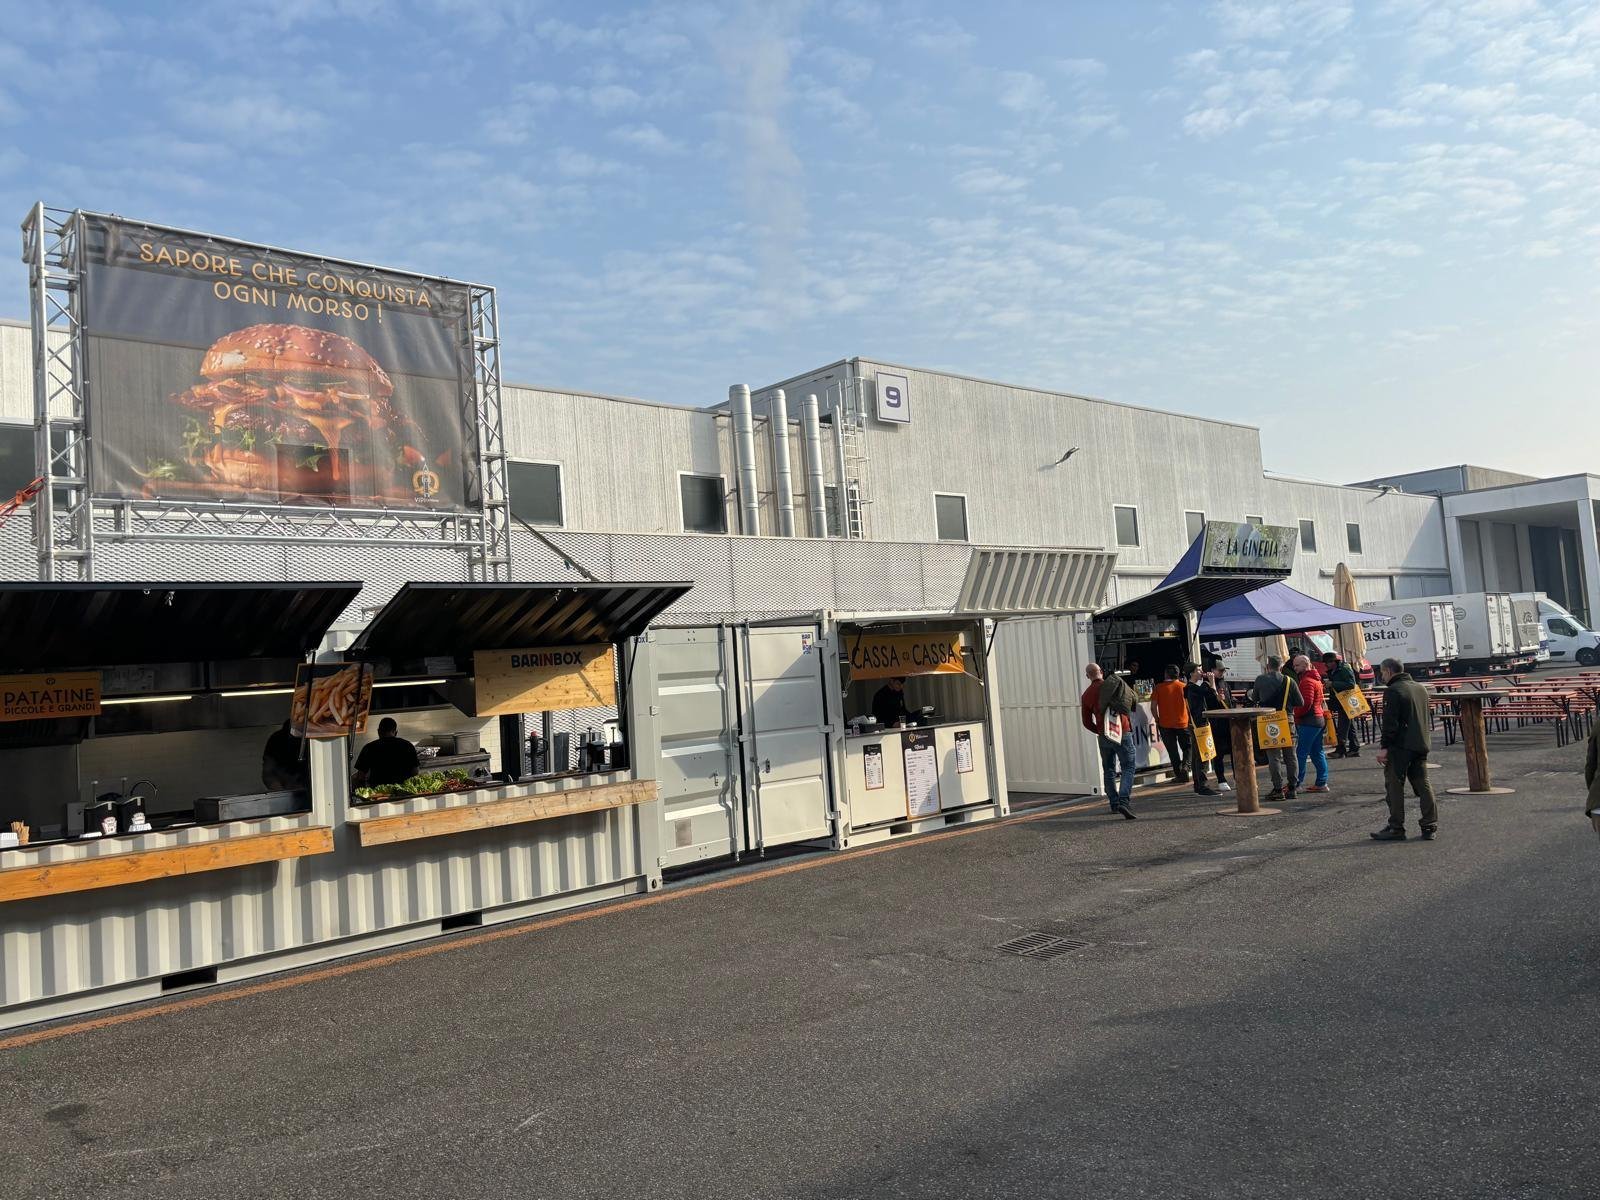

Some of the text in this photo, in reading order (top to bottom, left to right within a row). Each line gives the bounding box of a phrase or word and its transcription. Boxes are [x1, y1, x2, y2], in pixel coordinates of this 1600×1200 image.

[139, 243, 432, 309] SAPORE CHE CONQUISTA
[213, 281, 277, 307] OGNI
[287, 293, 369, 321] MORSO
[886, 386, 901, 408] 9
[1226, 538, 1279, 558] LA GINERIA
[1363, 627, 1408, 642] astaio
[511, 651, 583, 668] BARINBOX
[852, 642, 957, 670] CASSA CASSA
[4, 687, 95, 706] PATATINE
[4, 703, 96, 716] PICCOLE E GRANDI
